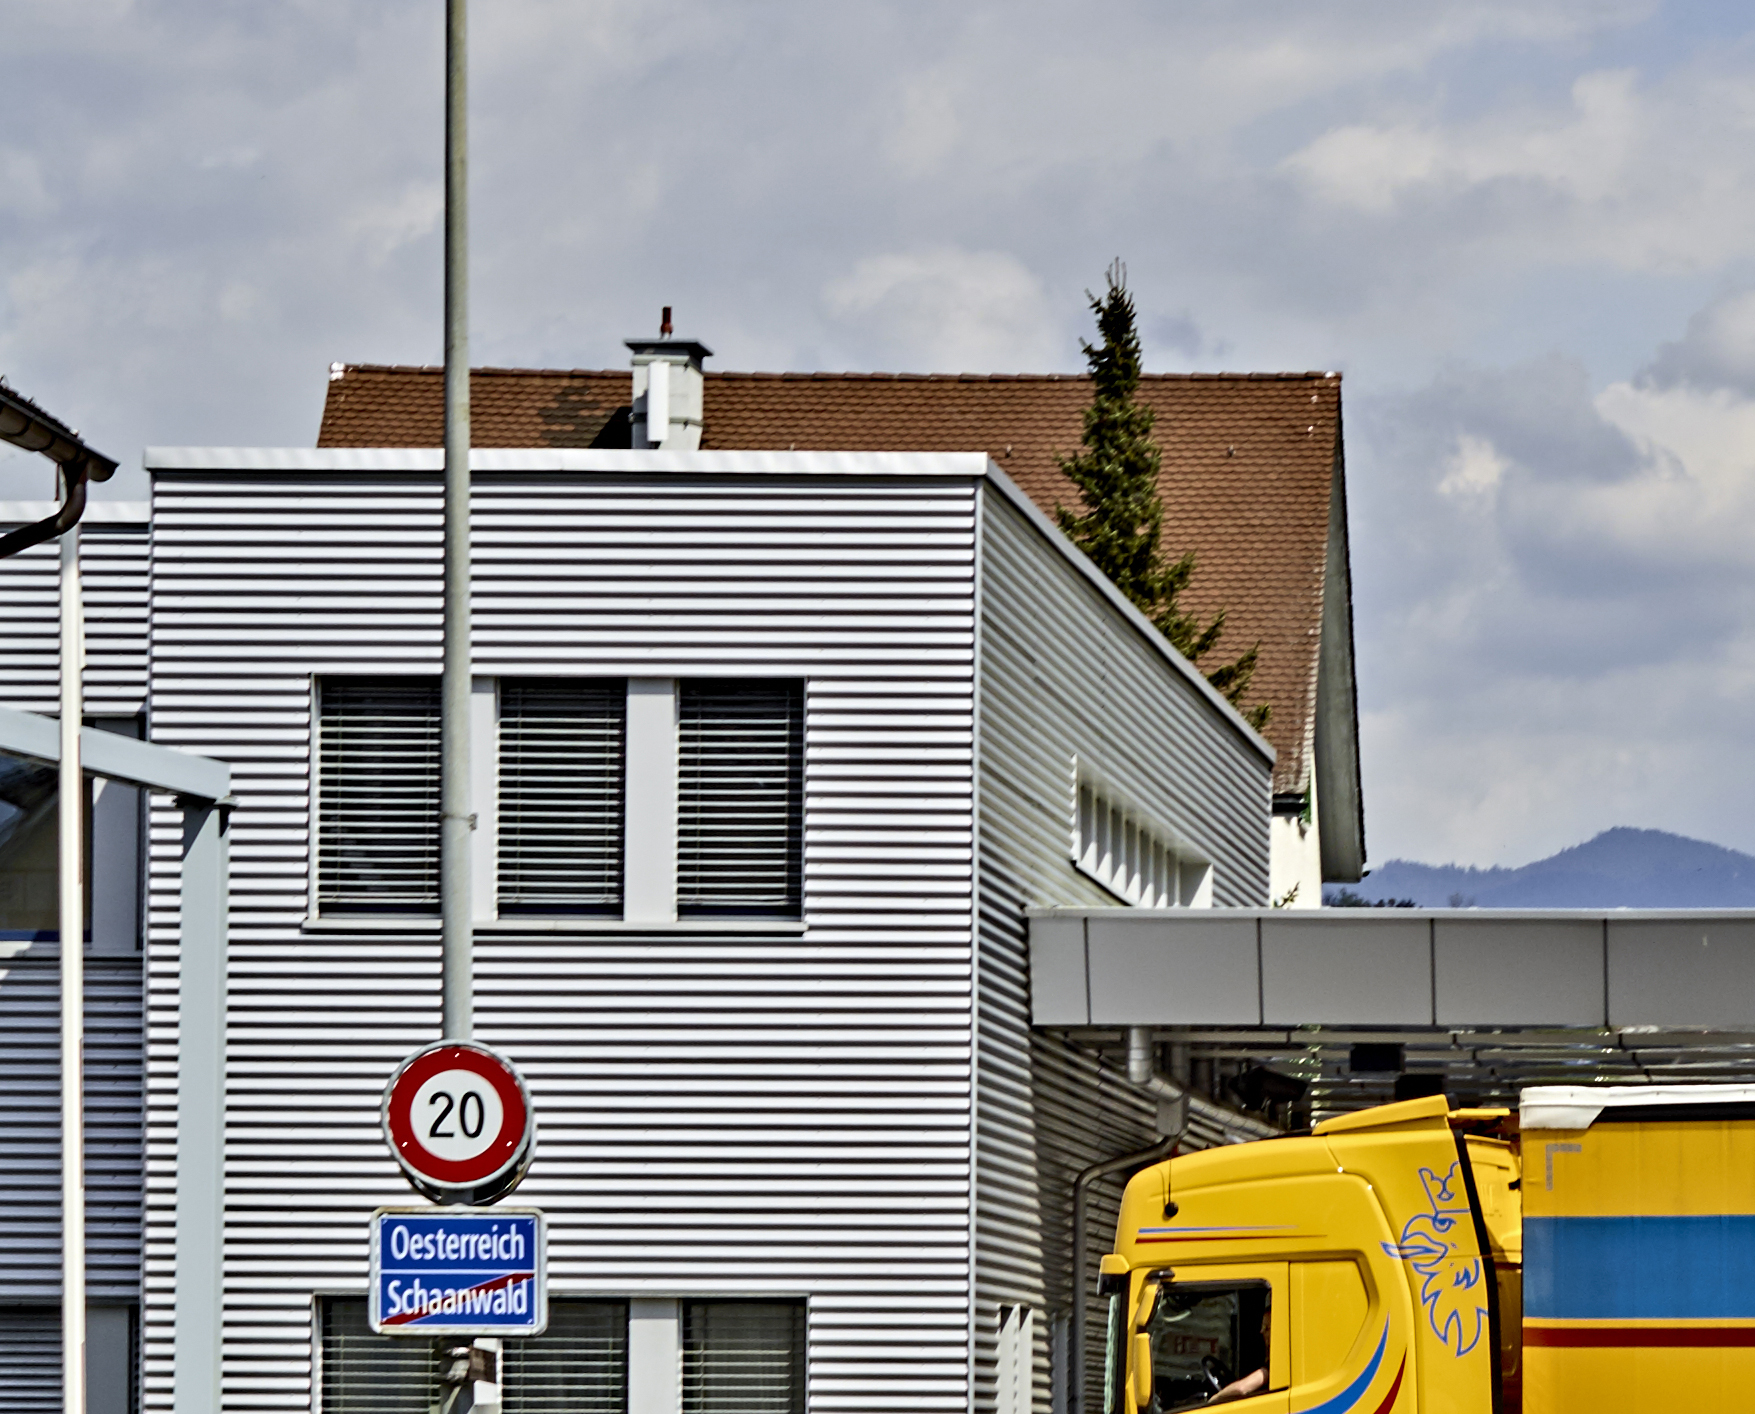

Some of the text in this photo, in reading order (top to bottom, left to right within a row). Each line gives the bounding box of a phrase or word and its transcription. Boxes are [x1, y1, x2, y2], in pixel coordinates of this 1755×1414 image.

[428, 1091, 485, 1139] 20
[390, 1223, 525, 1261] Oesterreich
[387, 1278, 528, 1317] Schaanwald
